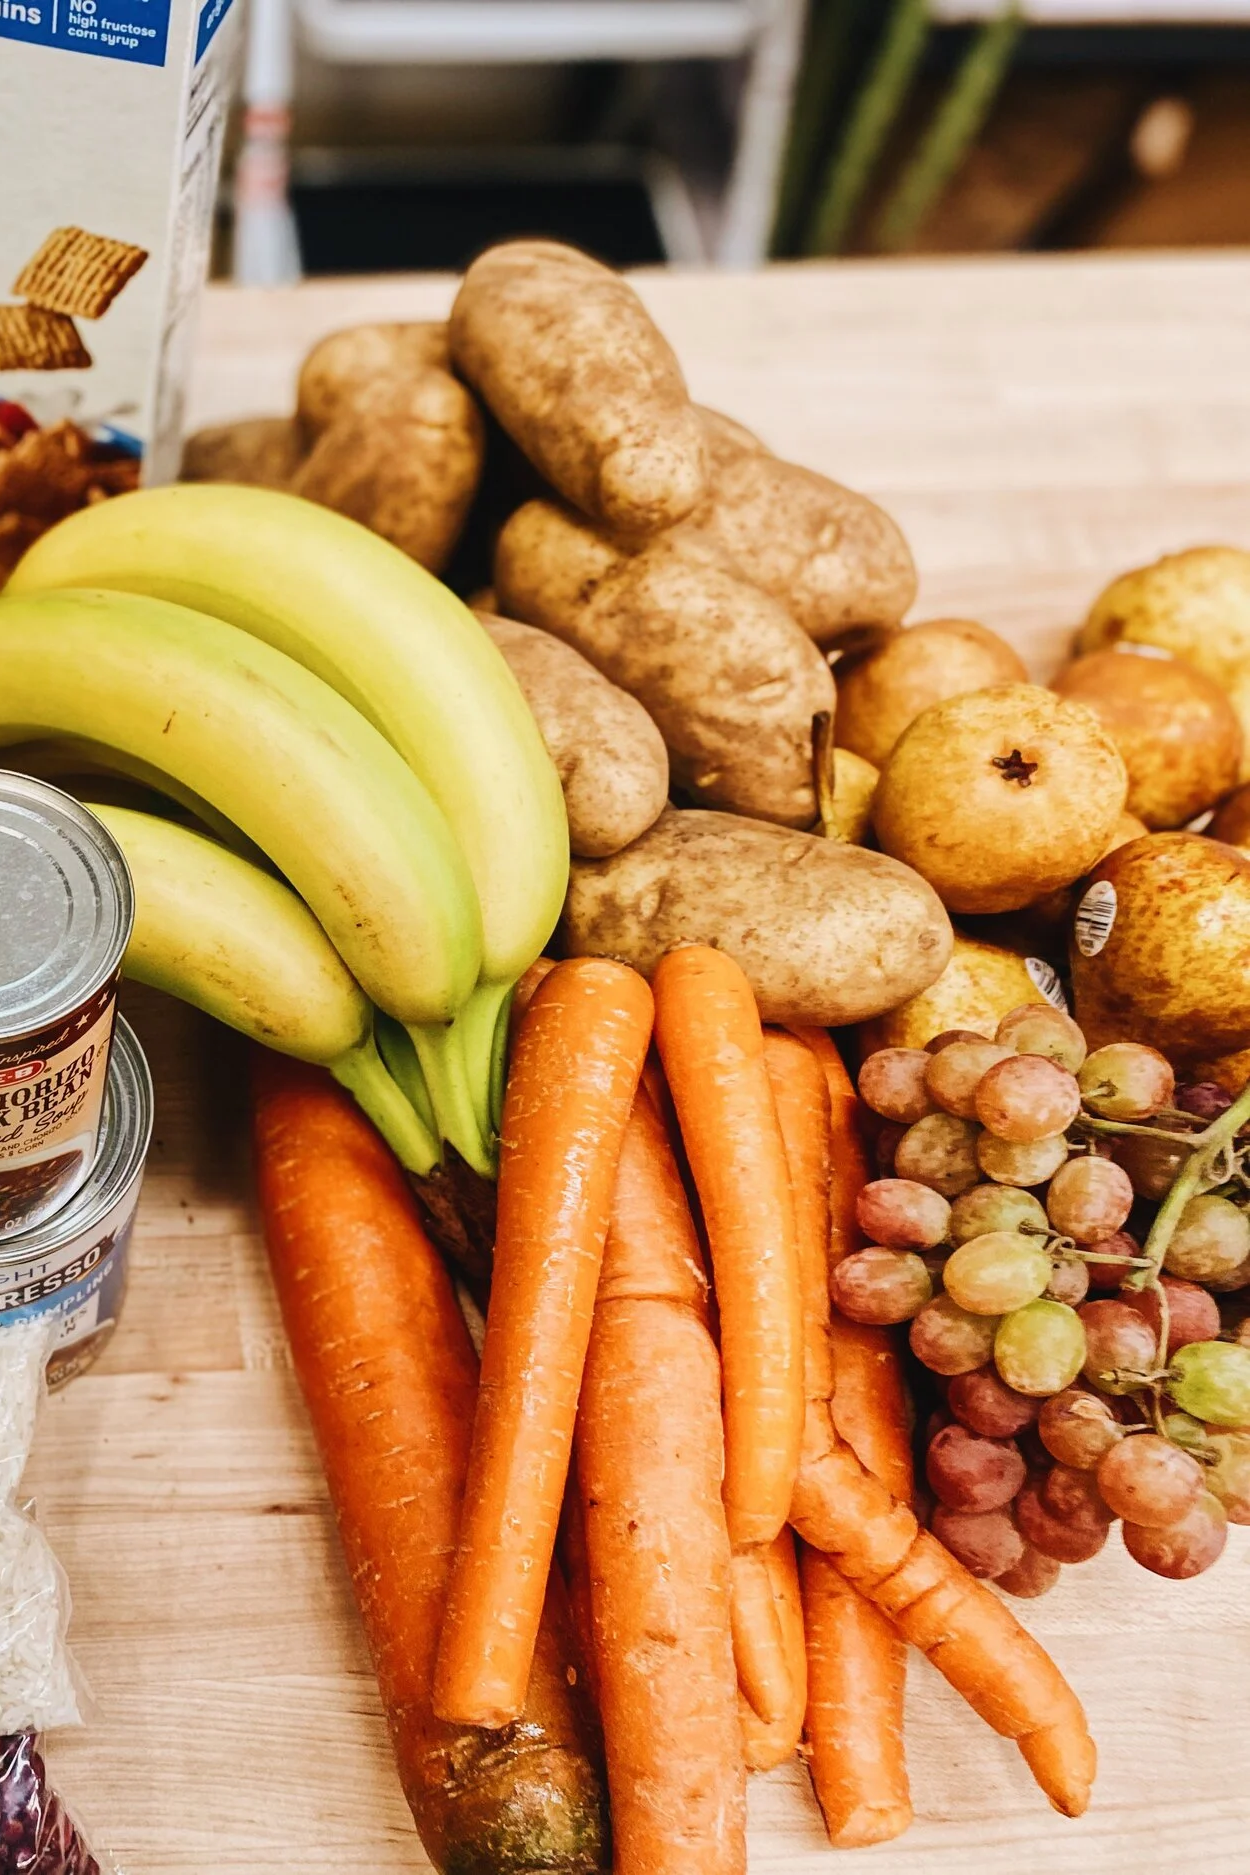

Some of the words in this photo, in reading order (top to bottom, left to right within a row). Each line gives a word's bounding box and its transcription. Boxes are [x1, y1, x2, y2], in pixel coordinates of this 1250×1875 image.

[69, 0, 97, 15] NO
[68, 12, 98, 29] high
[100, 18, 157, 38] fructose
[67, 27, 98, 40] corn
[100, 31, 139, 49] syrup
[21, 1066, 94, 1122] BEAN
[34, 1088, 90, 1135] Soup
[0, 1142, 21, 1155] AND
[23, 1123, 63, 1145] CHORIZO
[17, 1140, 45, 1156] CORN
[4, 1216, 23, 1231] OZ
